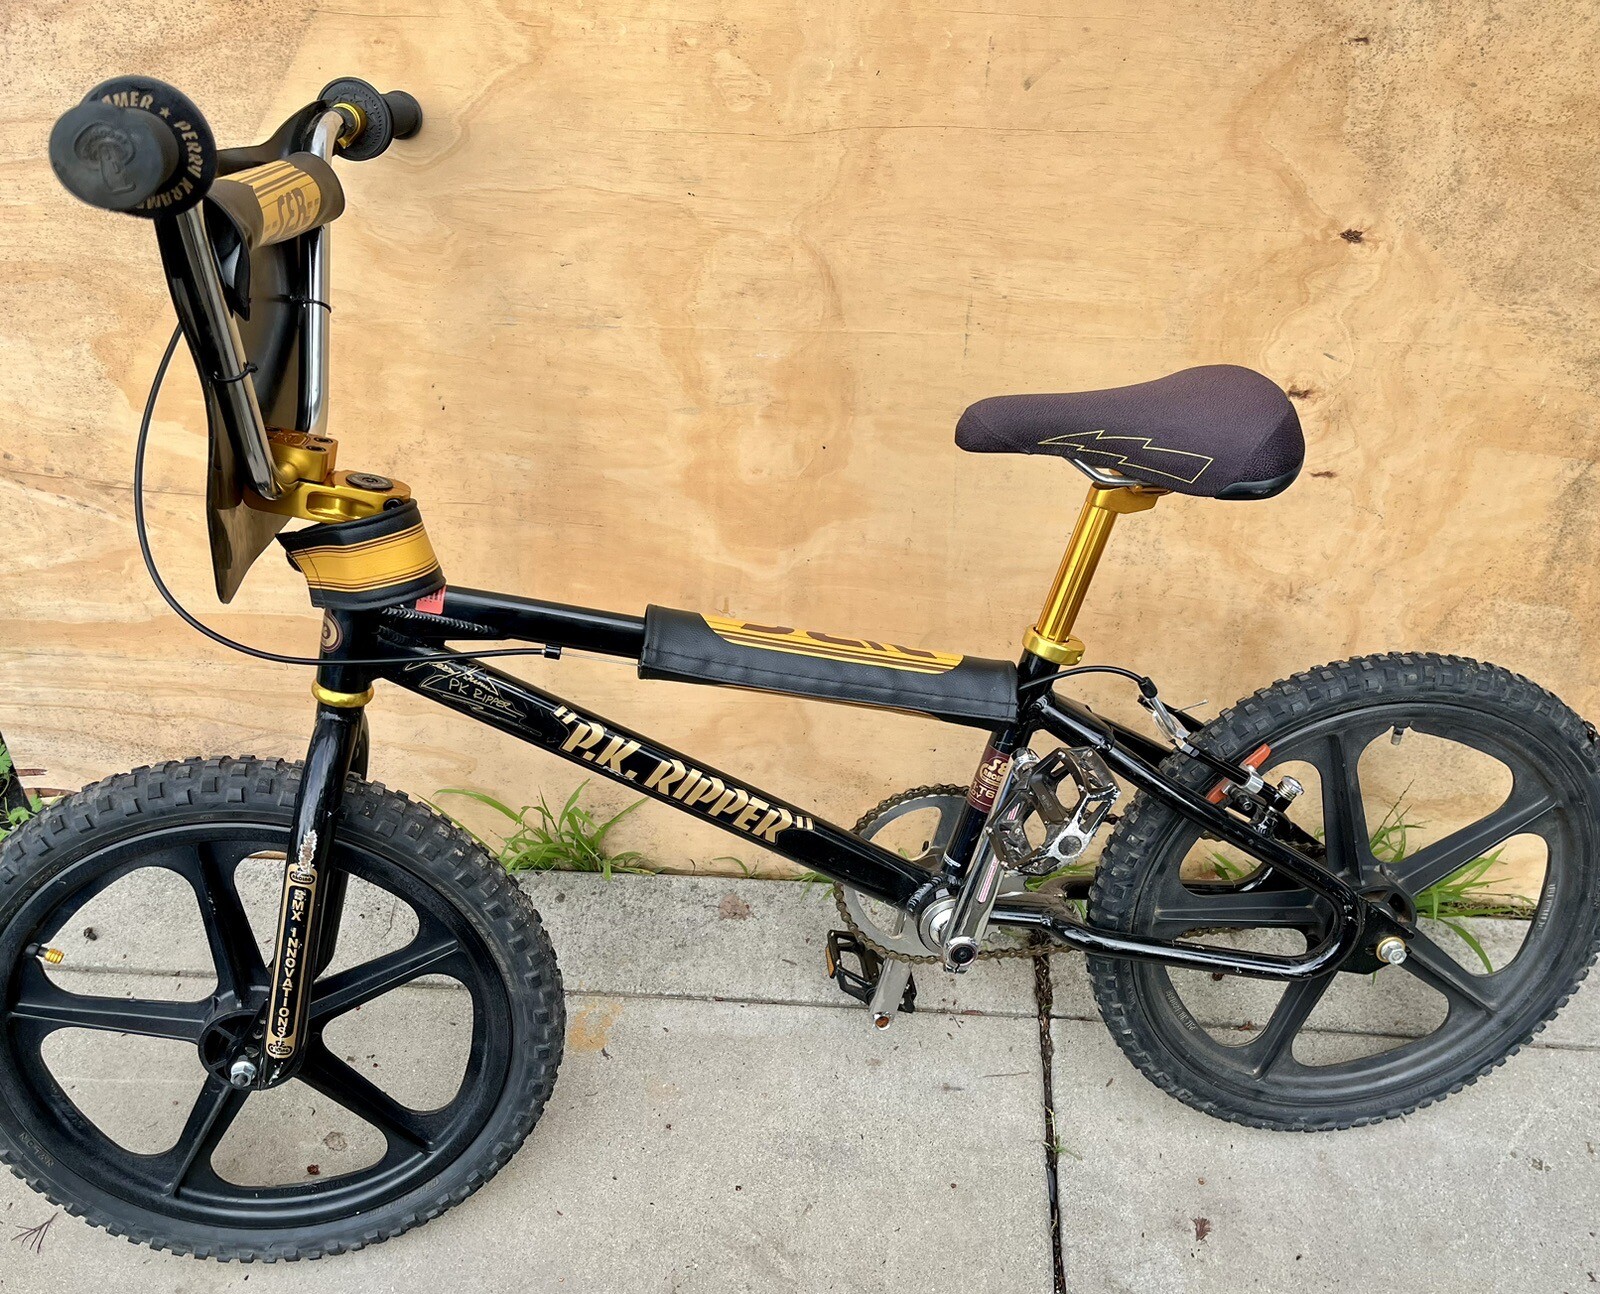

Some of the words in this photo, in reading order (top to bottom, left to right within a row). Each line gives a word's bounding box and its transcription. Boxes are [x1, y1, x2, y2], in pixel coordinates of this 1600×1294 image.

[448, 678, 470, 695] PK
[473, 689, 515, 709] RIPPER
[643, 758, 814, 844] RIPPER"
[277, 927, 301, 1037] INNOVATIONS
